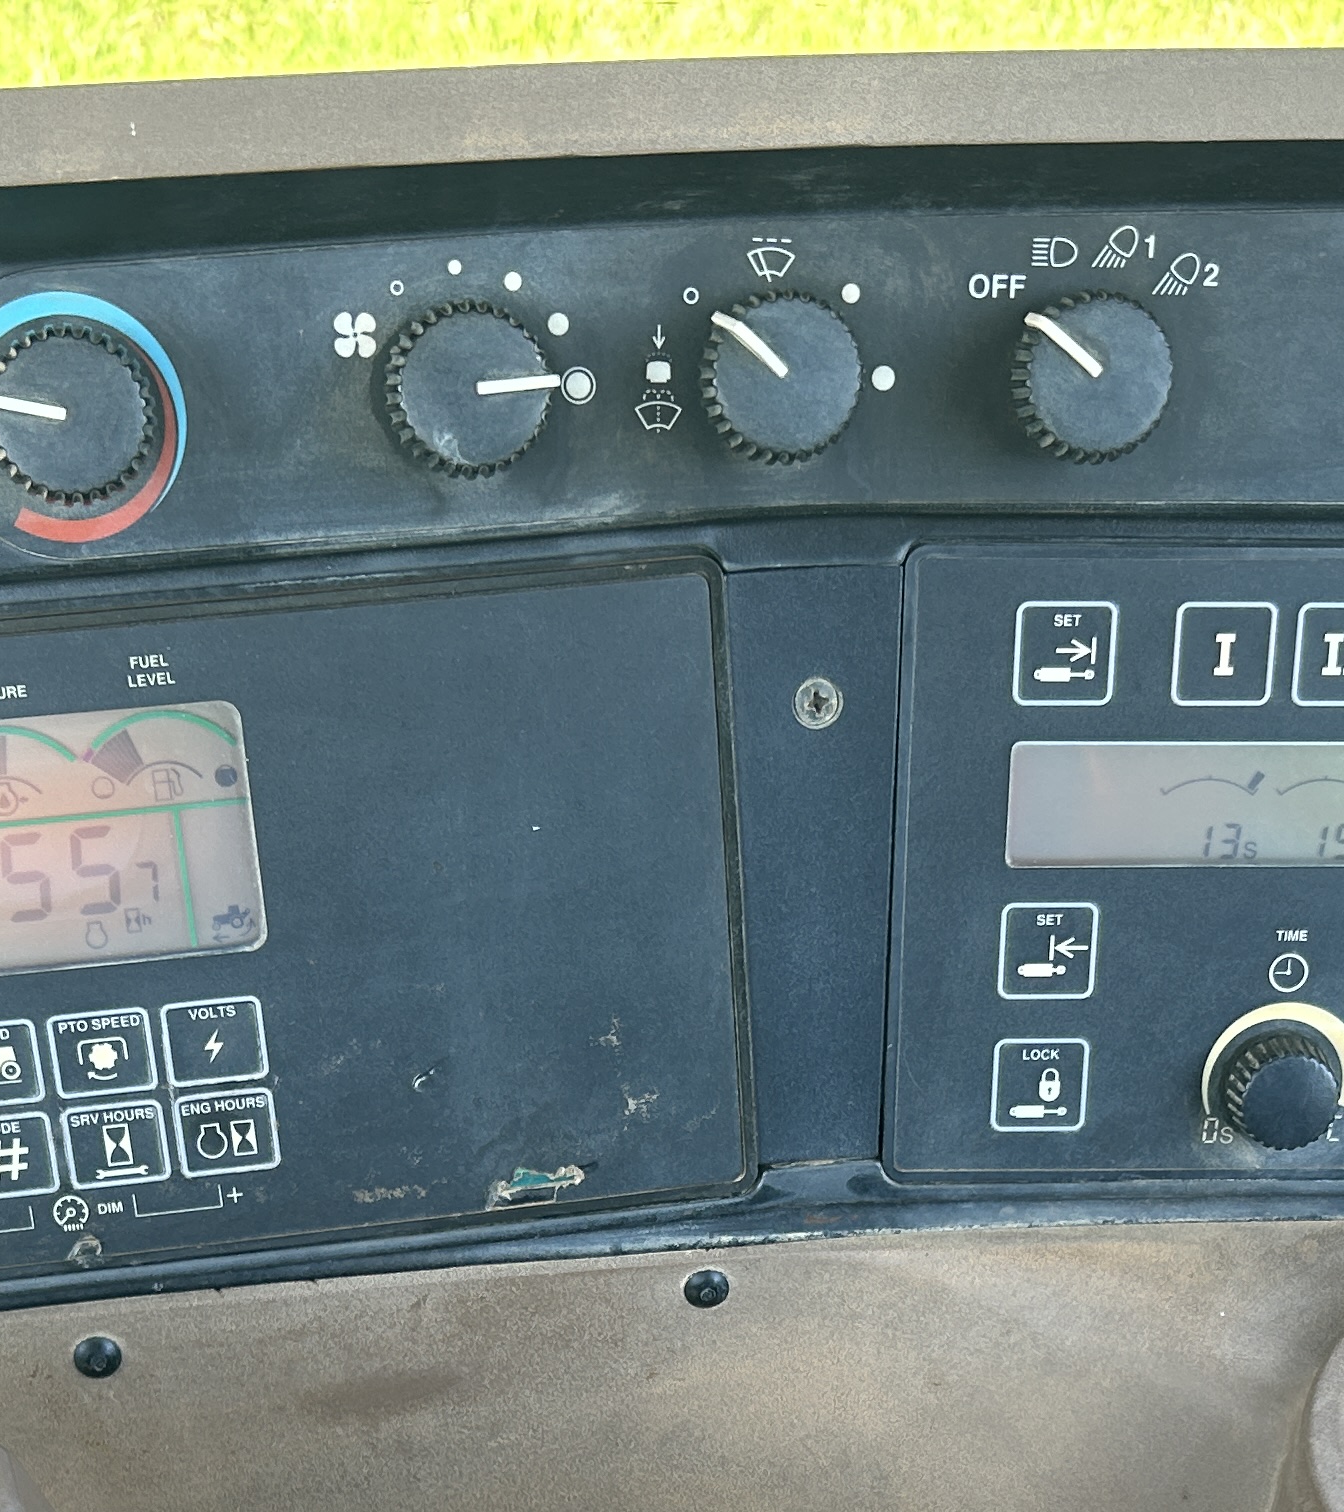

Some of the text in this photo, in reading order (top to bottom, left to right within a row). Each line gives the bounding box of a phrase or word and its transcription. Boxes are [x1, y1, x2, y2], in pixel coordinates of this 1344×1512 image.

[1145, 235, 1155, 258] 1
[1203, 263, 1219, 286] 2
[969, 274, 1026, 298] OFF
[1054, 614, 1081, 626] SET
[130, 654, 169, 669] FUEL
[128, 672, 175, 687] LEVEL
[1037, 914, 1063, 925] SET
[1276, 930, 1308, 941] TIME
[188, 1005, 236, 1020] VOLTS
[58, 1015, 141, 1034] PTO SPEED
[1023, 1049, 1059, 1060] LOCK
[181, 1095, 266, 1118] ENG HOURS
[70, 1107, 155, 1128] SRV HOURS
[98, 1201, 123, 1214] DIM
